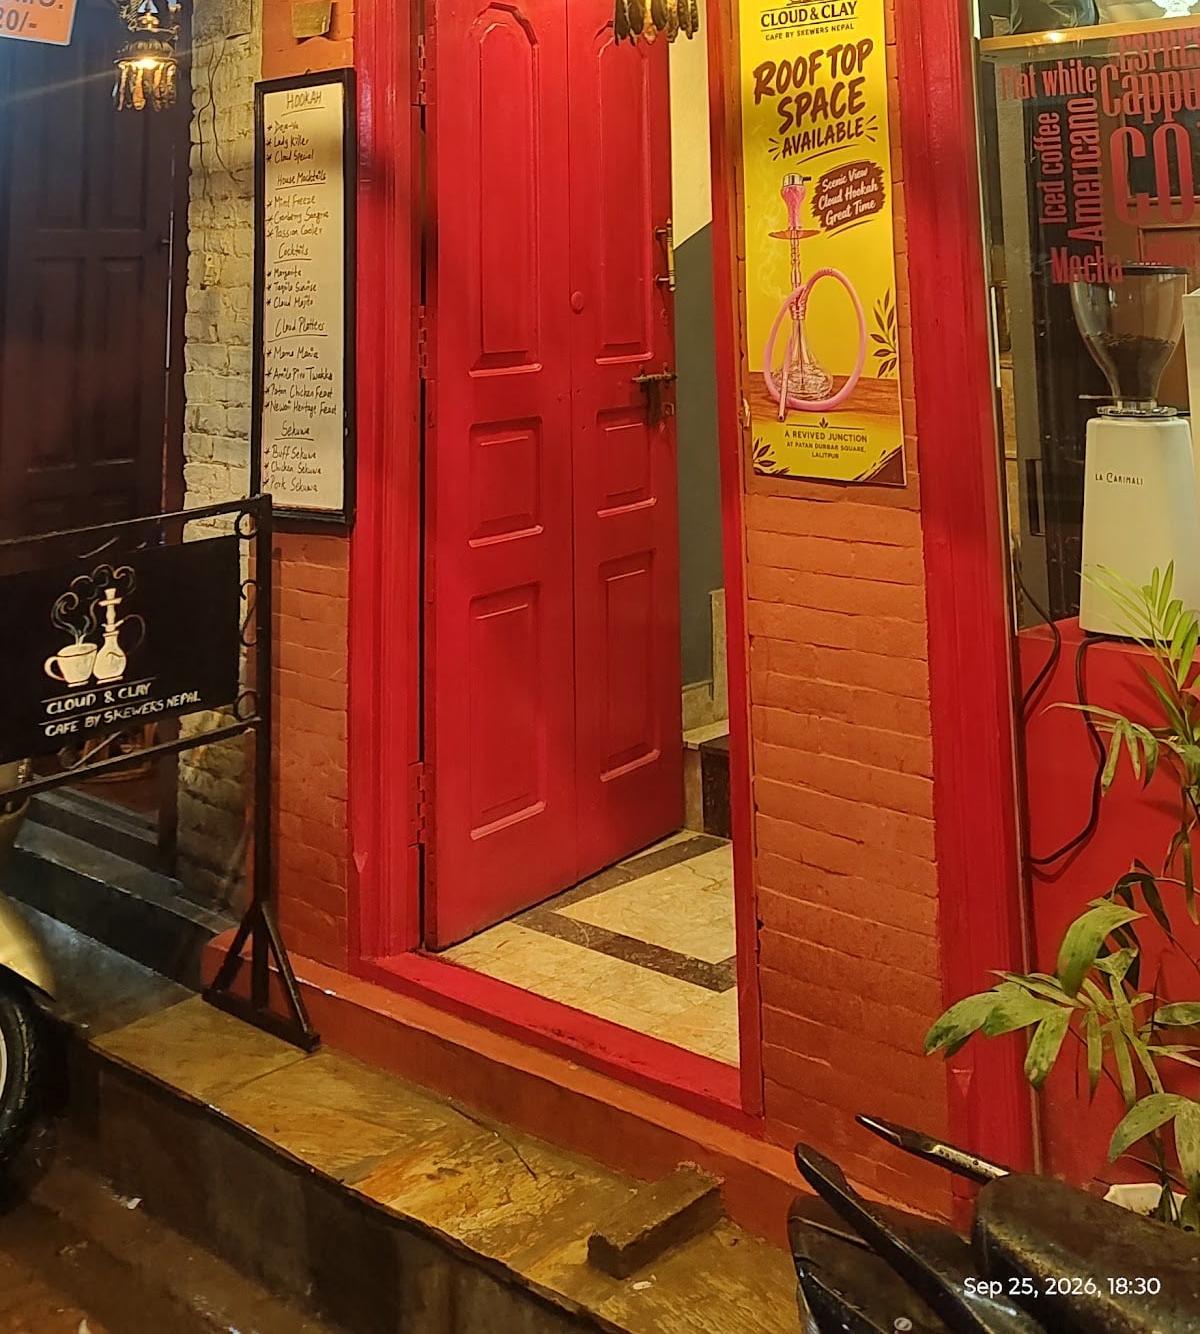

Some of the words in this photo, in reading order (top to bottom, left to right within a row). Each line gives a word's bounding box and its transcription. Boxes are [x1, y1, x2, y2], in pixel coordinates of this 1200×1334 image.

[761, 9, 808, 28] CLOUD
[810, 7, 819, 21] &
[821, 0, 858, 19] CLAY
[765, 32, 783, 41] CAFE
[797, 26, 829, 37] SKEWERS
[831, 23, 854, 32] NEPAL
[1042, 58, 1098, 99] white
[286, 90, 322, 110] HOOKAH
[777, 76, 866, 135] SPACE
[274, 135, 288, 149] Lady
[291, 134, 309, 147] Killer
[782, 117, 864, 159] AVAILABLE
[1033, 112, 1063, 176] coffee
[274, 150, 292, 163] Cloud
[293, 149, 314, 164] Special
[1067, 97, 1105, 242] Americano
[821, 174, 848, 193] Scenic
[848, 167, 868, 182] View
[1110, 122, 1200, 226] CO
[818, 188, 843, 211] Cloud
[844, 177, 879, 201] Hookah
[1037, 174, 1070, 224] Iced
[825, 204, 852, 226] Great
[852, 199, 877, 215] Time
[274, 226, 298, 238] Passion
[1051, 246, 1124, 284] Mocha
[274, 295, 291, 308] Cloud
[275, 318, 296, 337] Cloud
[290, 384, 314, 398] Chicken
[315, 385, 333, 399] Feast
[319, 401, 337, 416] Feast
[784, 430, 791, 438] A
[792, 430, 826, 440] REVIVED
[828, 432, 868, 443] JUNCTION
[794, 441, 813, 449] PATAN
[814, 443, 839, 451] DURBAR
[840, 445, 867, 453] SQUARE,
[271, 444, 290, 459] Buff
[1095, 473, 1104, 481] LA
[46, 693, 97, 715] CLOUD
[104, 690, 115, 704] &
[118, 682, 152, 699] CLAY
[44, 720, 79, 737] CAFE
[84, 714, 101, 729] BY
[103, 699, 164, 724] SKEWERS
[166, 690, 201, 710] NEPAL
